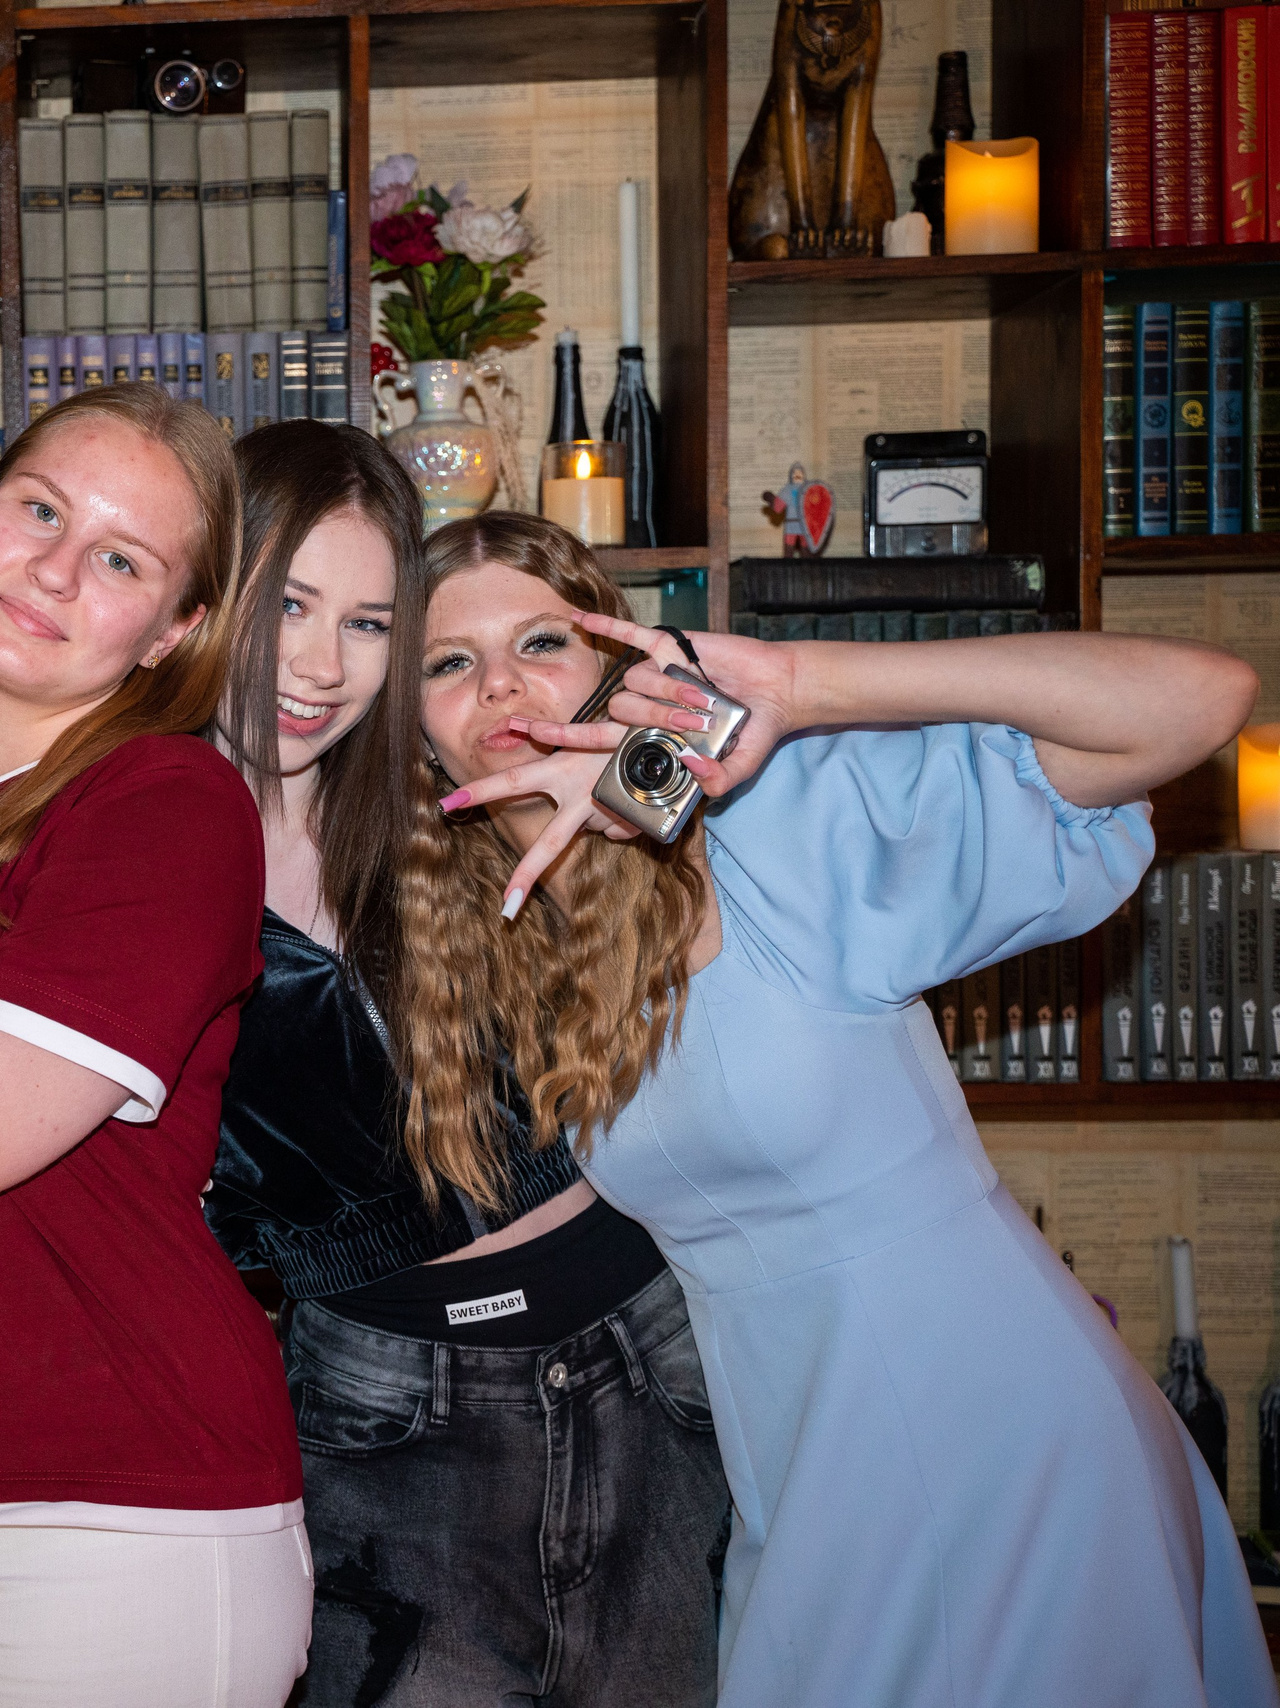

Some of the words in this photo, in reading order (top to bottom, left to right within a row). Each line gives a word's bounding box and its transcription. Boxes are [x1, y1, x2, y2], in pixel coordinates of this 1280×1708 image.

[1179, 937, 1191, 993] ФЕДИН
[449, 1304, 489, 1319] SWEET
[492, 1296, 522, 1312] BABY
